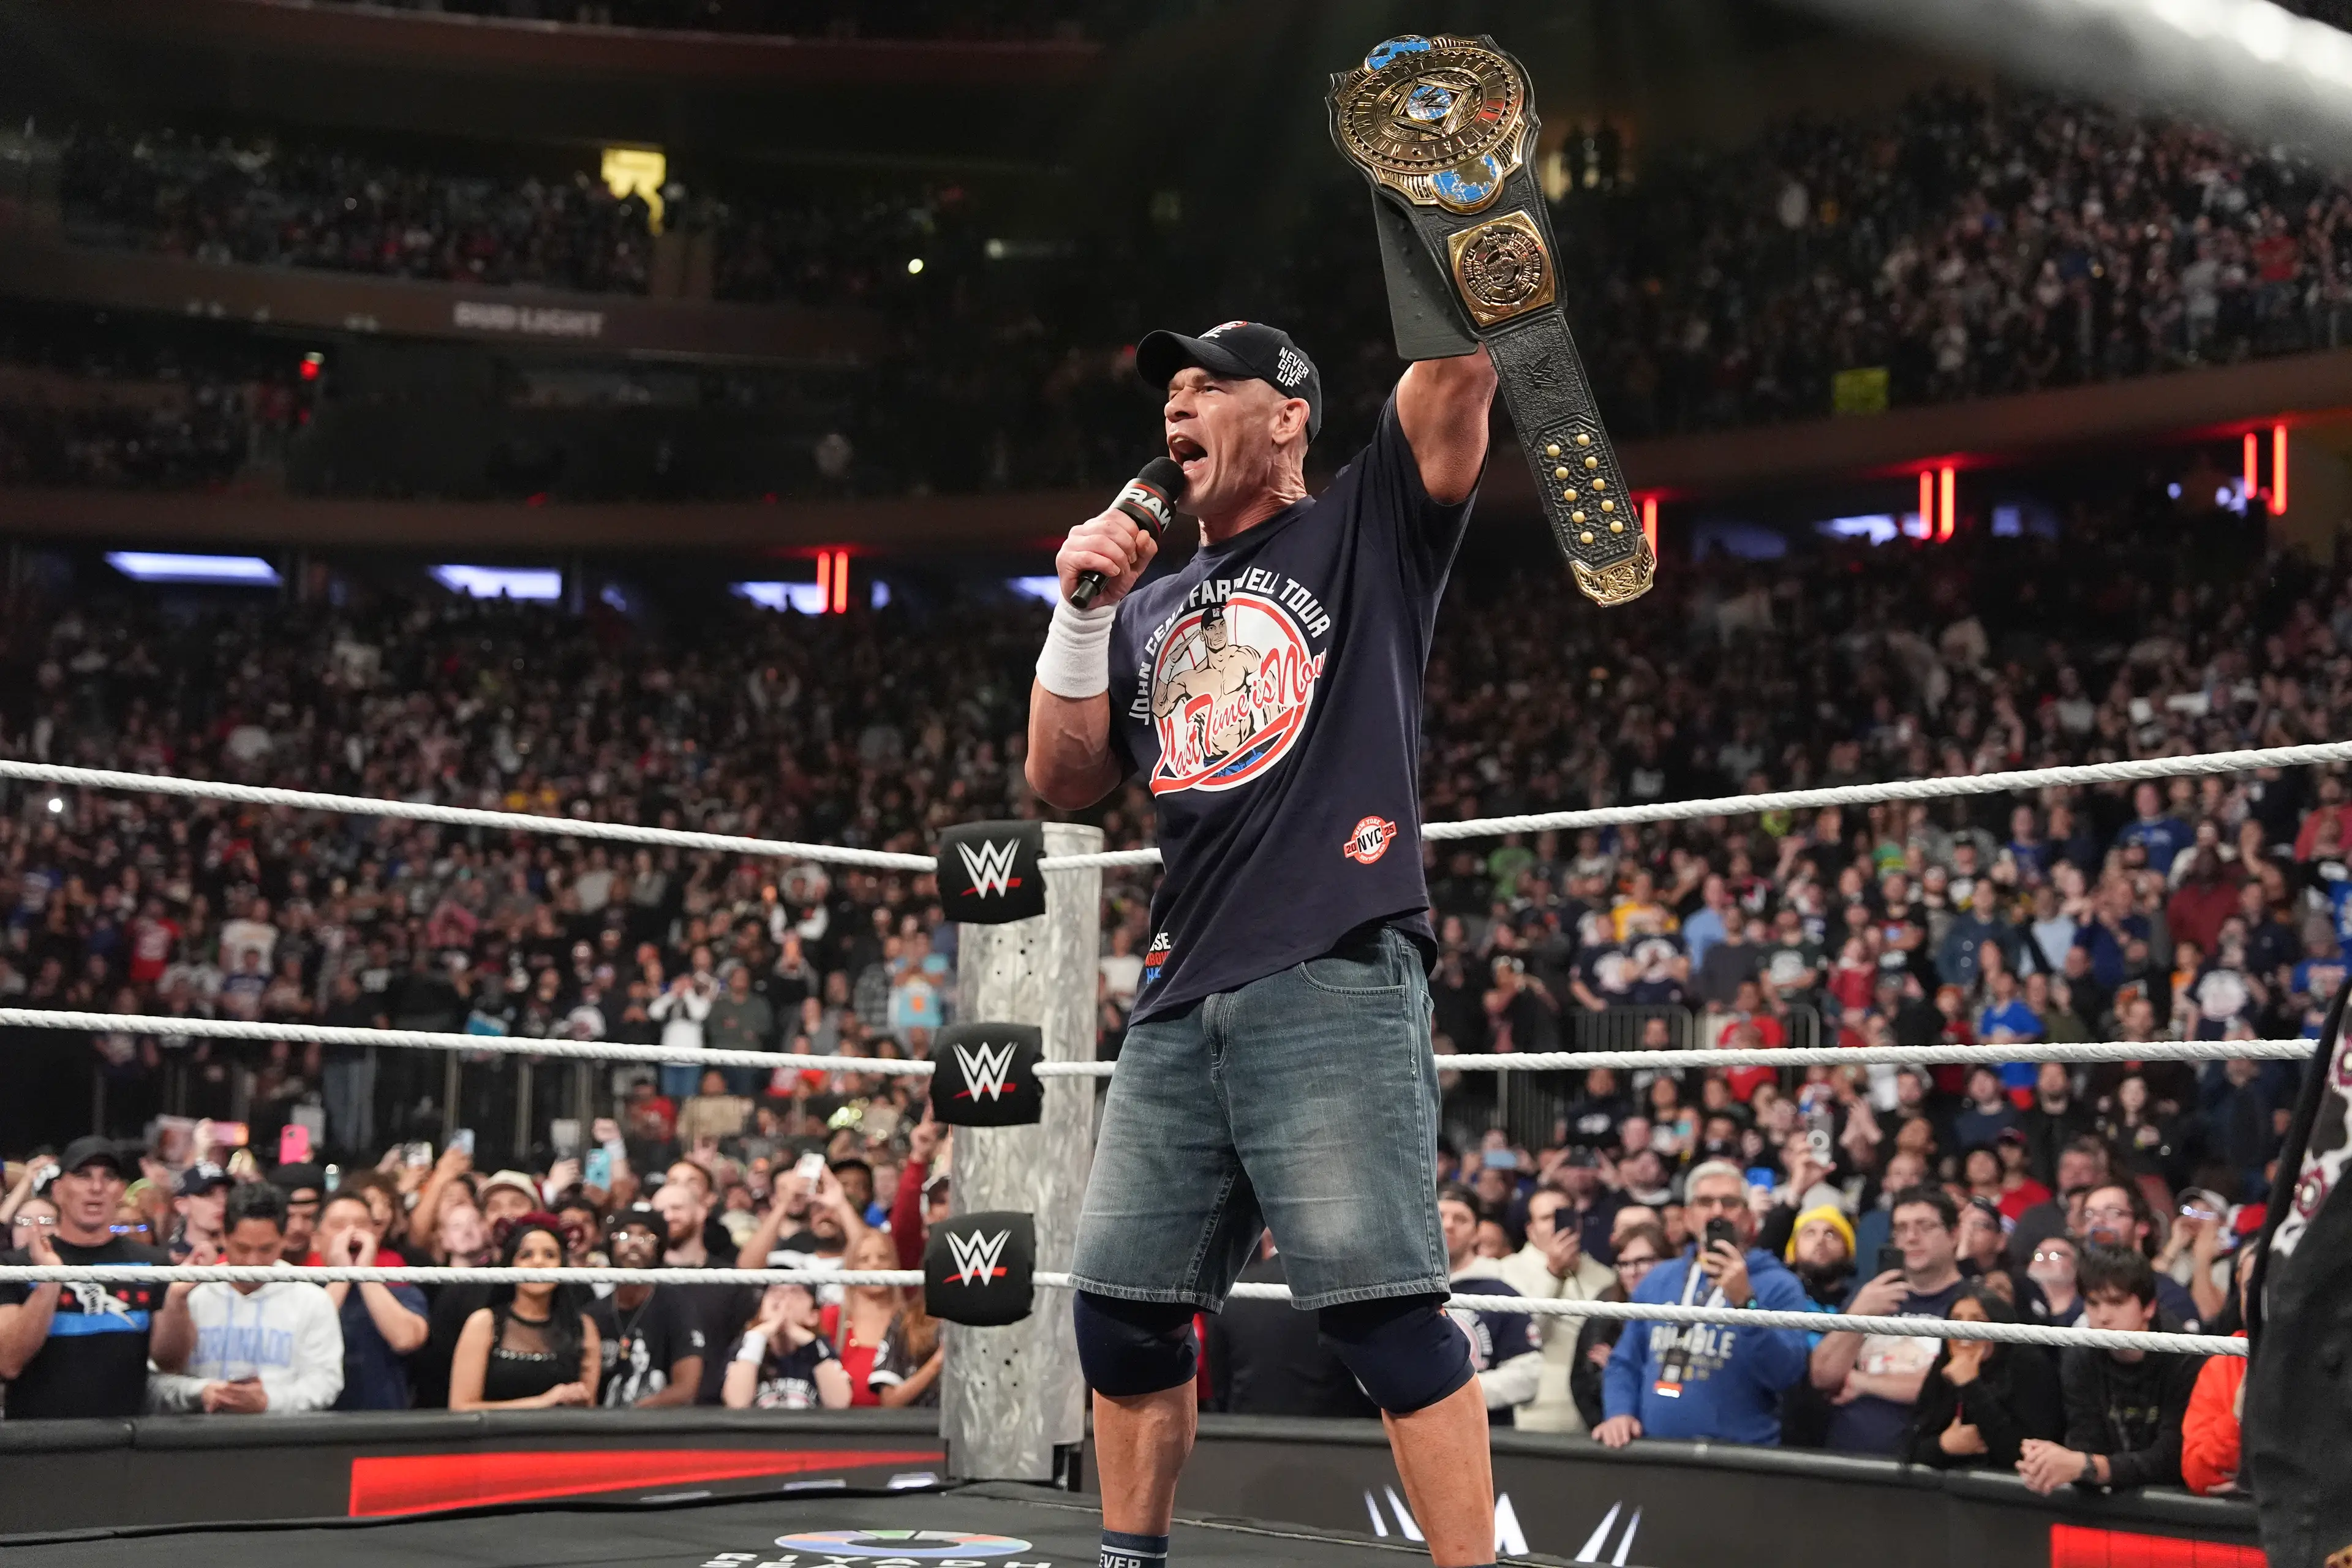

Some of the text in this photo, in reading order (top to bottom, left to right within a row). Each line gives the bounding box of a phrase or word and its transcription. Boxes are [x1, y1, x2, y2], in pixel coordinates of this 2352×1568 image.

[1354, 92, 1403, 157] CHAMPION
[1278, 359, 1303, 385] GIVE
[1279, 347, 1309, 379] NEVER
[1276, 371, 1295, 387] UP
[1129, 566, 1331, 725] JOHN CENA FARELL TOUR
[1154, 717, 1204, 777] Last
[1185, 693, 1250, 755] Time
[1253, 680, 1275, 709] is
[1346, 824, 1394, 854] 20 25
[1355, 821, 1365, 836] NEW
[1357, 827, 1383, 852] NYC
[1145, 951, 1170, 967] ABOV
[714, 1552, 1052, 1568] RIYADH
[1099, 1553, 1141, 1568] EVER
